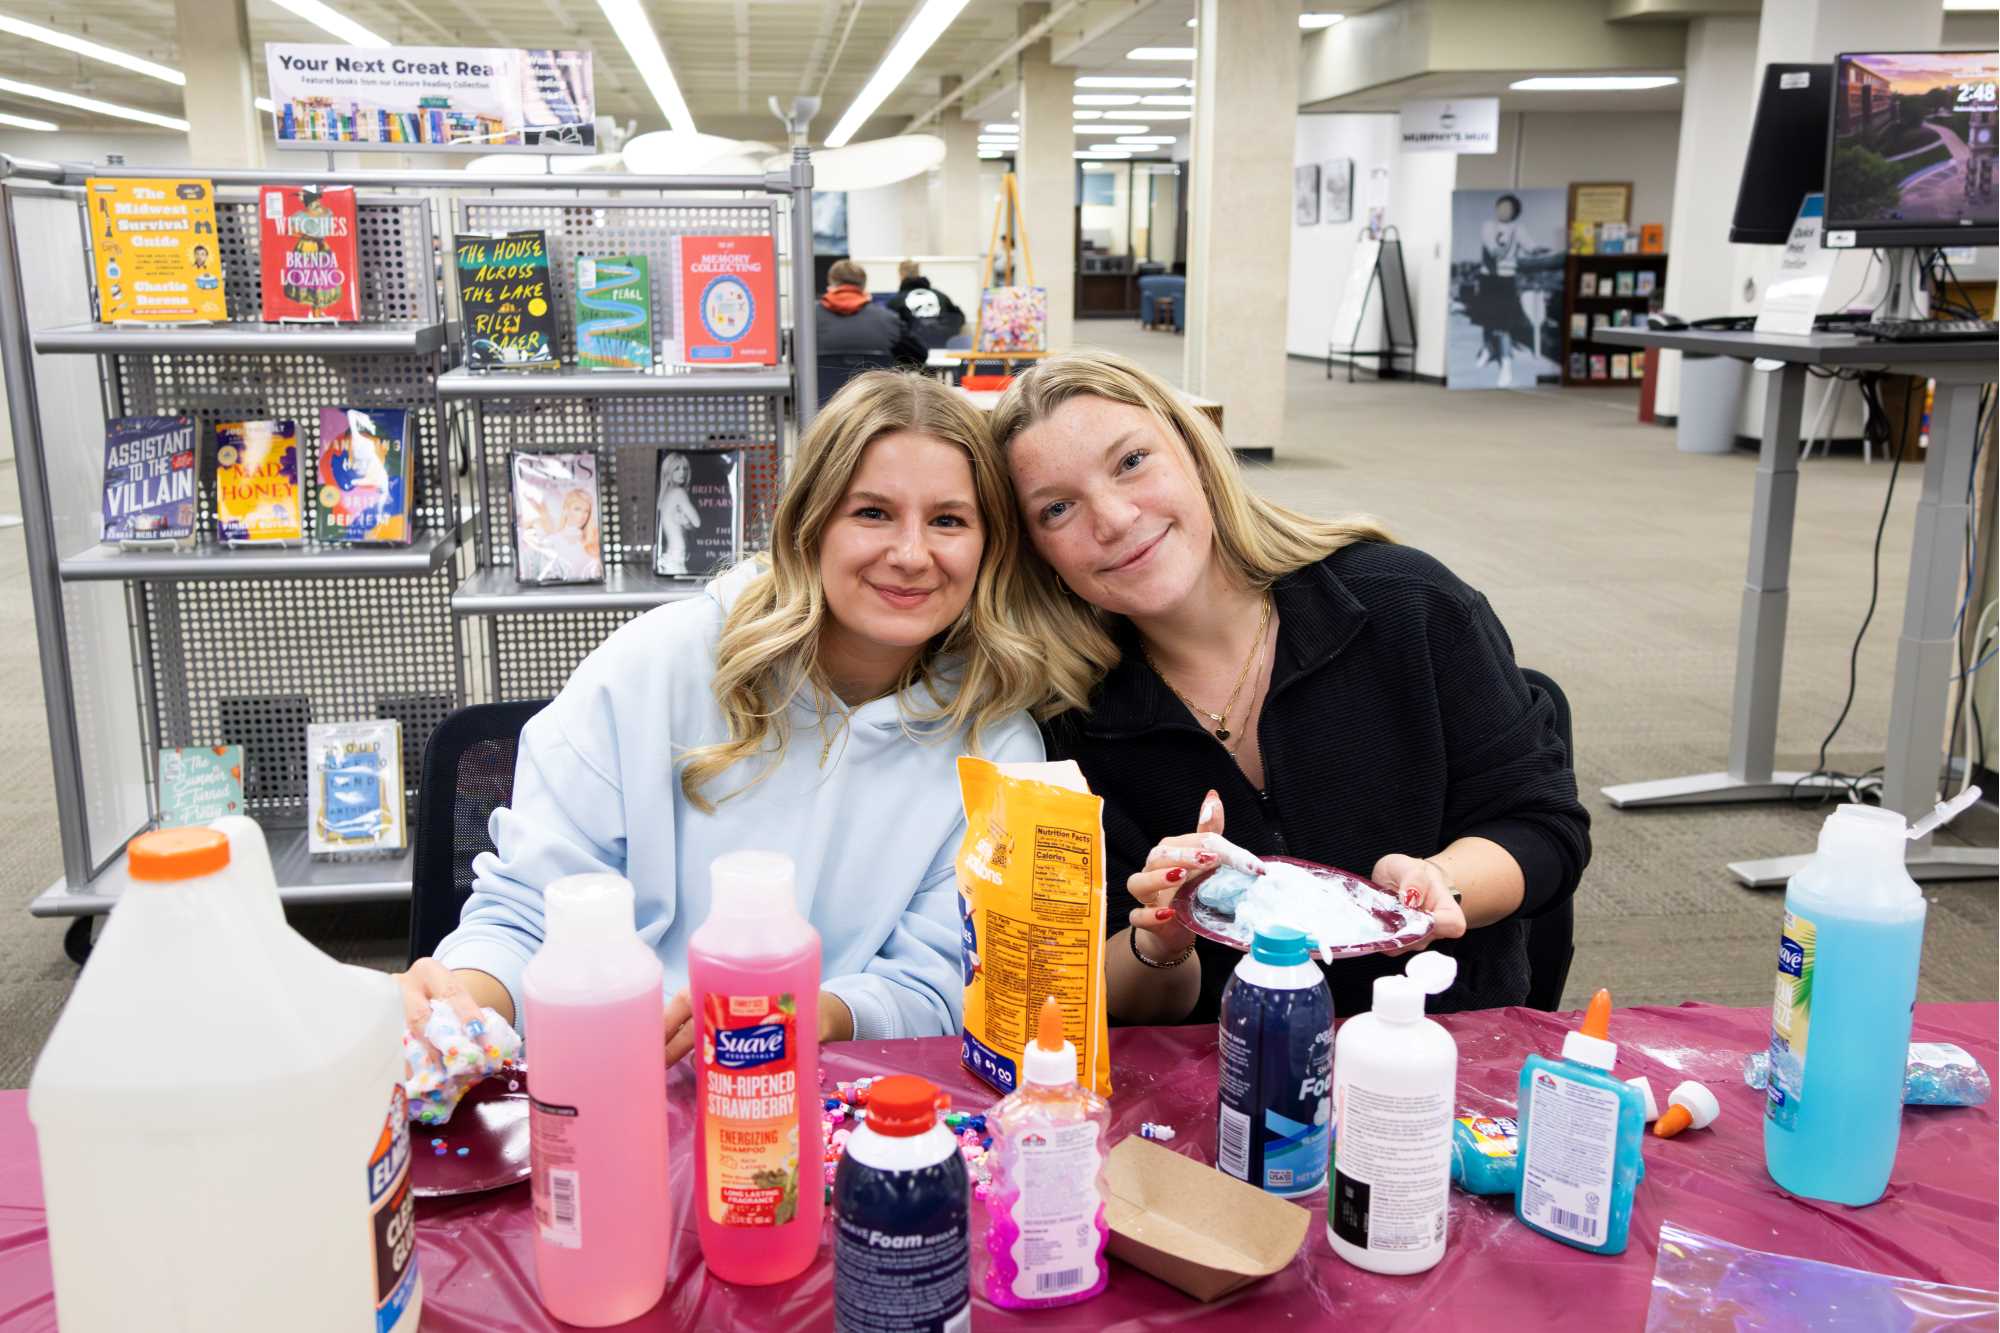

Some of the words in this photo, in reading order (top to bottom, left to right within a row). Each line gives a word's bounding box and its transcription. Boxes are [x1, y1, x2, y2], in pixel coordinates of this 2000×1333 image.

[280, 55, 328, 72] Your
[336, 57, 385, 73] Next
[392, 59, 449, 76] Great
[457, 61, 505, 77] Rea
[301, 77, 334, 86] Featured
[336, 77, 358, 87] books
[360, 78, 377, 88] from
[393, 80, 420, 89] Leisure
[421, 81, 451, 91] Reading
[453, 81, 490, 90] Collection
[1957, 83, 1996, 102] 2:48
[132, 187, 165, 200] The
[115, 202, 188, 215] Midwest
[117, 218, 190, 232] Survival
[275, 216, 348, 237] WITCHES
[130, 235, 180, 248] Guide
[285, 251, 338, 268] BRENDA
[457, 243, 486, 264] THE
[493, 238, 543, 260] HOUSE
[701, 254, 751, 264] MEMORY
[475, 263, 534, 281] ACROSS
[690, 263, 762, 273] COLLECTING
[280, 269, 345, 286] LOZANO
[133, 280, 188, 293] Charlie
[463, 284, 494, 304] THE
[499, 282, 544, 300] LAKE
[612, 289, 643, 301] PEARL
[474, 313, 522, 334] RILEY
[488, 331, 540, 351] SAGER
[107, 428, 193, 470] ASSISTANT
[128, 464, 143, 481] TO
[149, 458, 169, 477] THE
[233, 463, 281, 479] MAD
[106, 468, 193, 517] VILLAIN
[222, 484, 294, 500] HONEY
[189, 755, 209, 769] The
[1037, 828, 1070, 838] Nutrition
[1071, 833, 1090, 844] Facts
[1036, 851, 1066, 862] Calories
[1082, 856, 1089, 865] 0
[719, 1031, 783, 1052] Suave
[707, 1070, 795, 1098] SUN-RIPENED
[708, 1091, 796, 1120] STRAWBERRY
[720, 1129, 778, 1145] ENERGIZING
[720, 1145, 766, 1153] SHAMPOO
[869, 1231, 923, 1248] Foam
